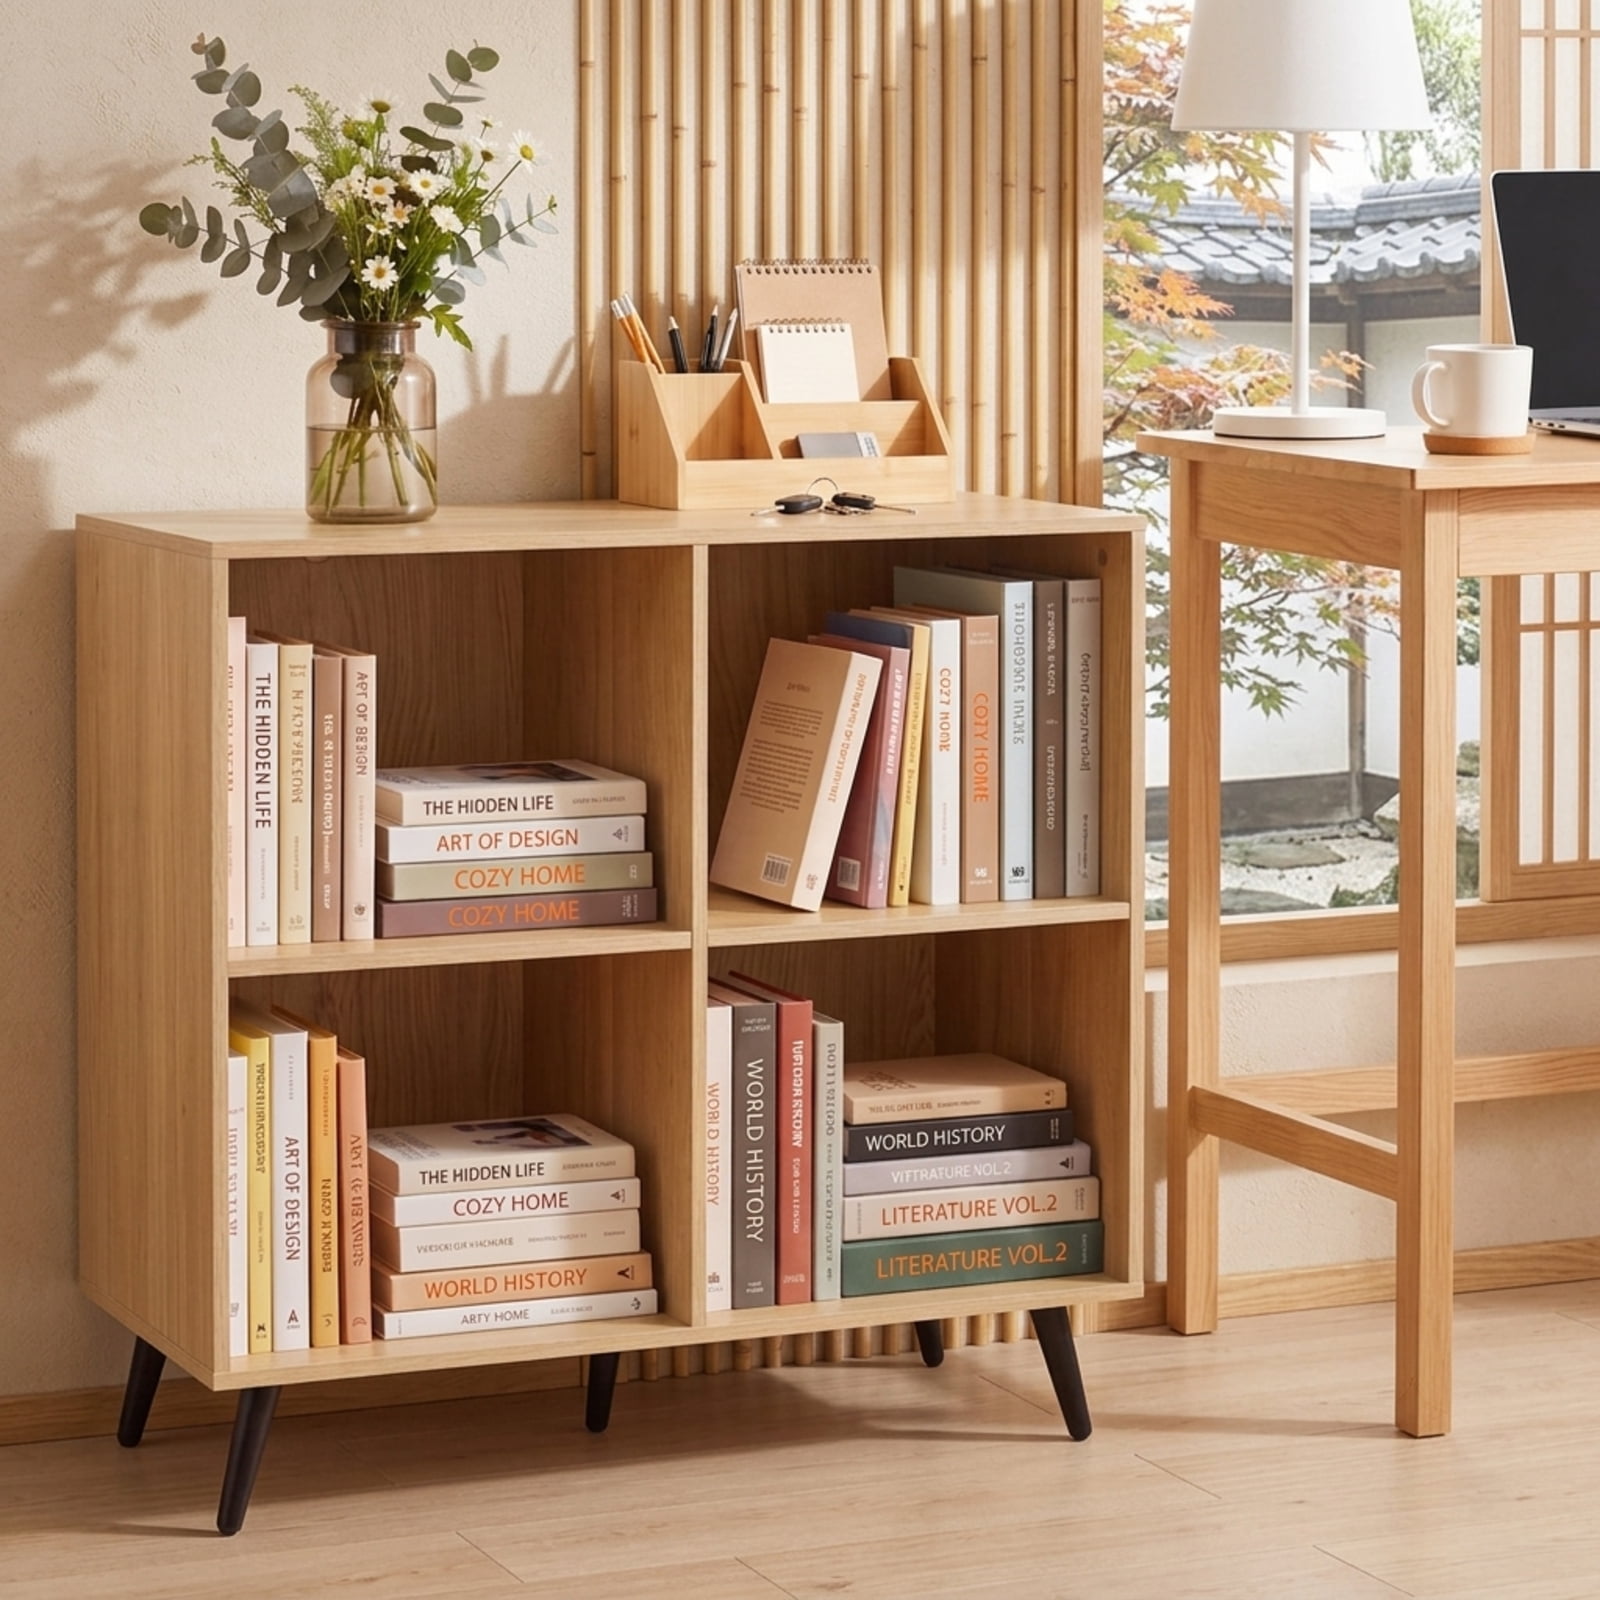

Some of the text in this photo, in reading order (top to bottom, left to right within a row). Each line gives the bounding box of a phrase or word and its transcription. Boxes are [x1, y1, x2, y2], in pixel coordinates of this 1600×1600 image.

[255, 673, 271, 829] THE HIDDEN LIFE
[423, 800, 454, 816] THE
[522, 795, 554, 811] LIFE
[436, 828, 579, 852] ART OF DESIGN
[453, 863, 586, 890] COZY HOME
[448, 900, 580, 928] COZY HOME
[746, 1058, 765, 1243] WORLD HISTORY
[865, 1124, 1006, 1152] WORLD HISTORY
[419, 1169, 449, 1186] THE
[452, 1164, 512, 1183] HIDDEN
[515, 1161, 546, 1178] LIFE
[285, 1137, 300, 1261] ART OF DESIGN
[453, 1191, 570, 1217] COZY HOME
[881, 1194, 1058, 1227] LITERATURE VOL.2
[877, 1247, 1002, 1280] LITERATURE
[424, 1268, 588, 1300] WORLD HISTORY
[494, 1309, 530, 1323] HOME
